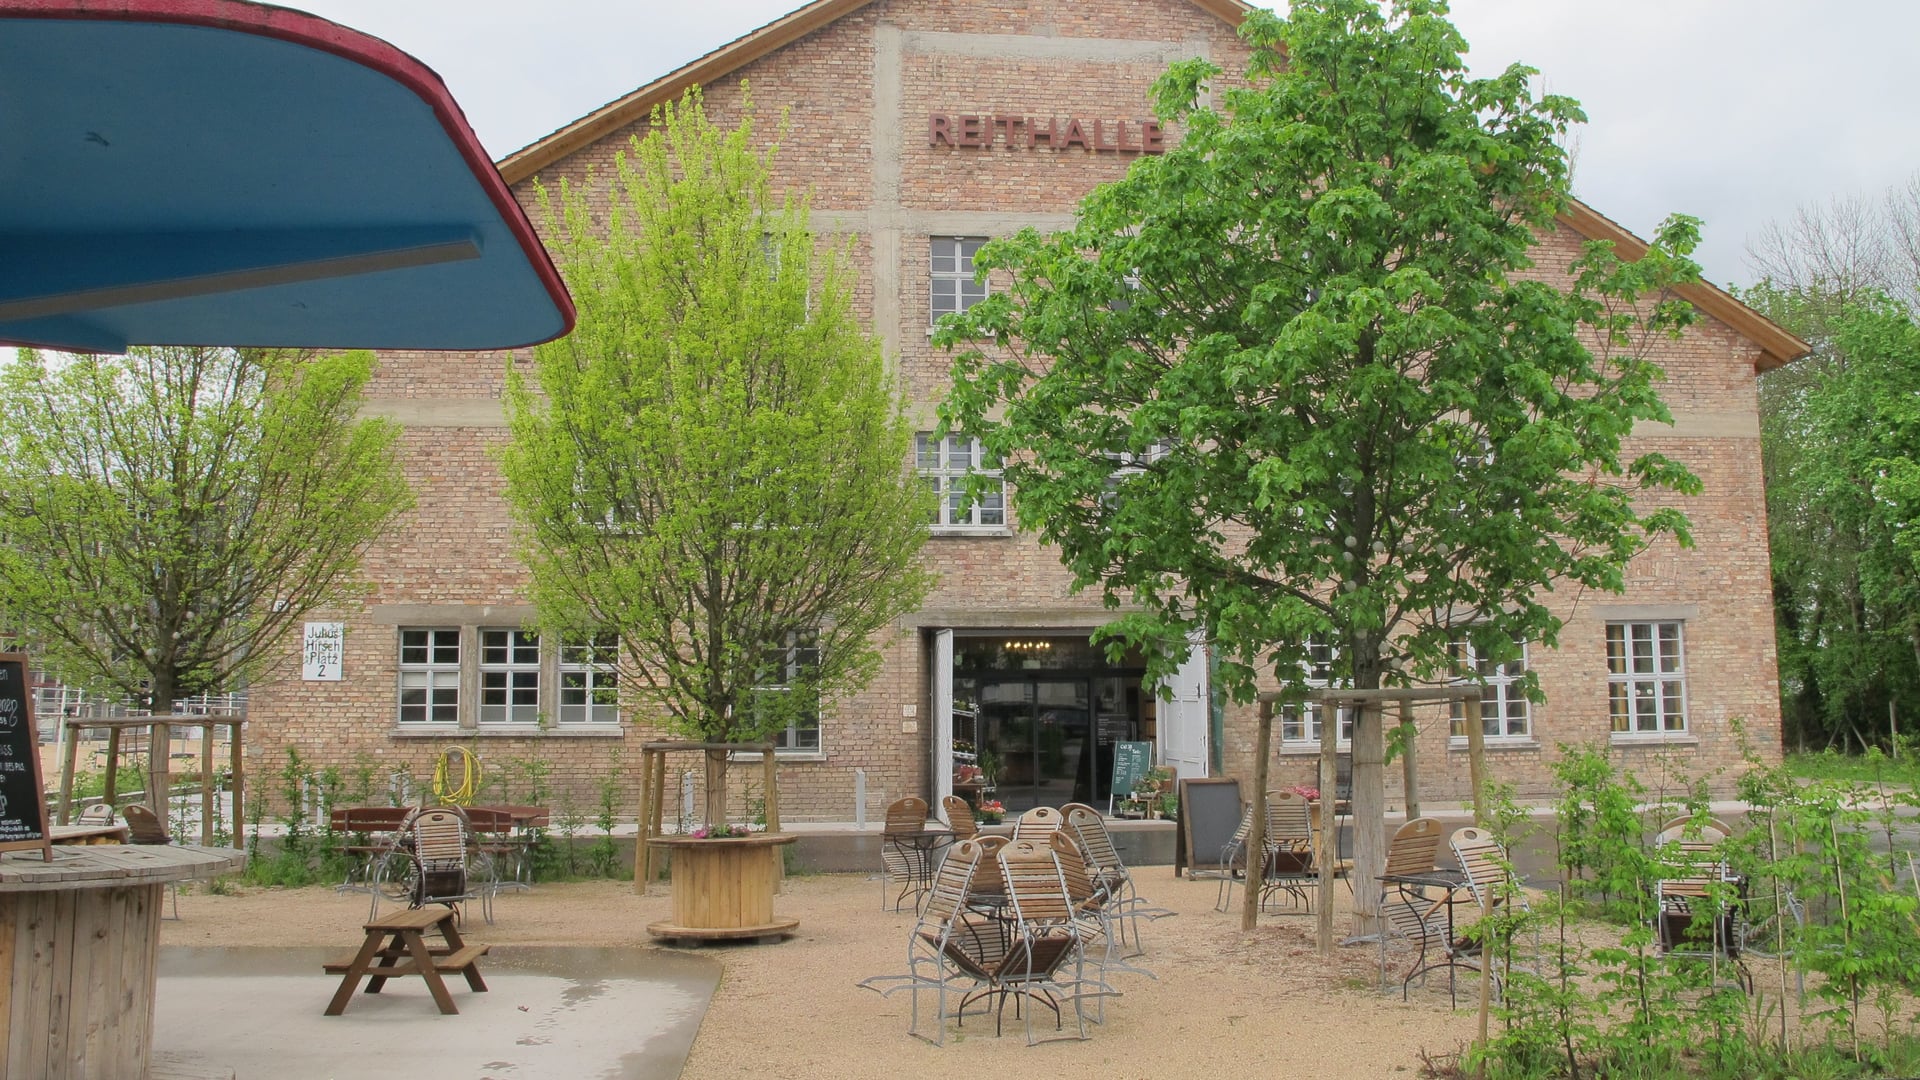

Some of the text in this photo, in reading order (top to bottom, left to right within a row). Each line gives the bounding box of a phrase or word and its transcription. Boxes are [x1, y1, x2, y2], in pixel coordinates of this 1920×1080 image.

[929, 113, 1165, 153] REITHALLE
[308, 626, 339, 639] Julius
[305, 640, 340, 652] Hirsch
[309, 651, 338, 665] Platz
[317, 664, 326, 677] 2
